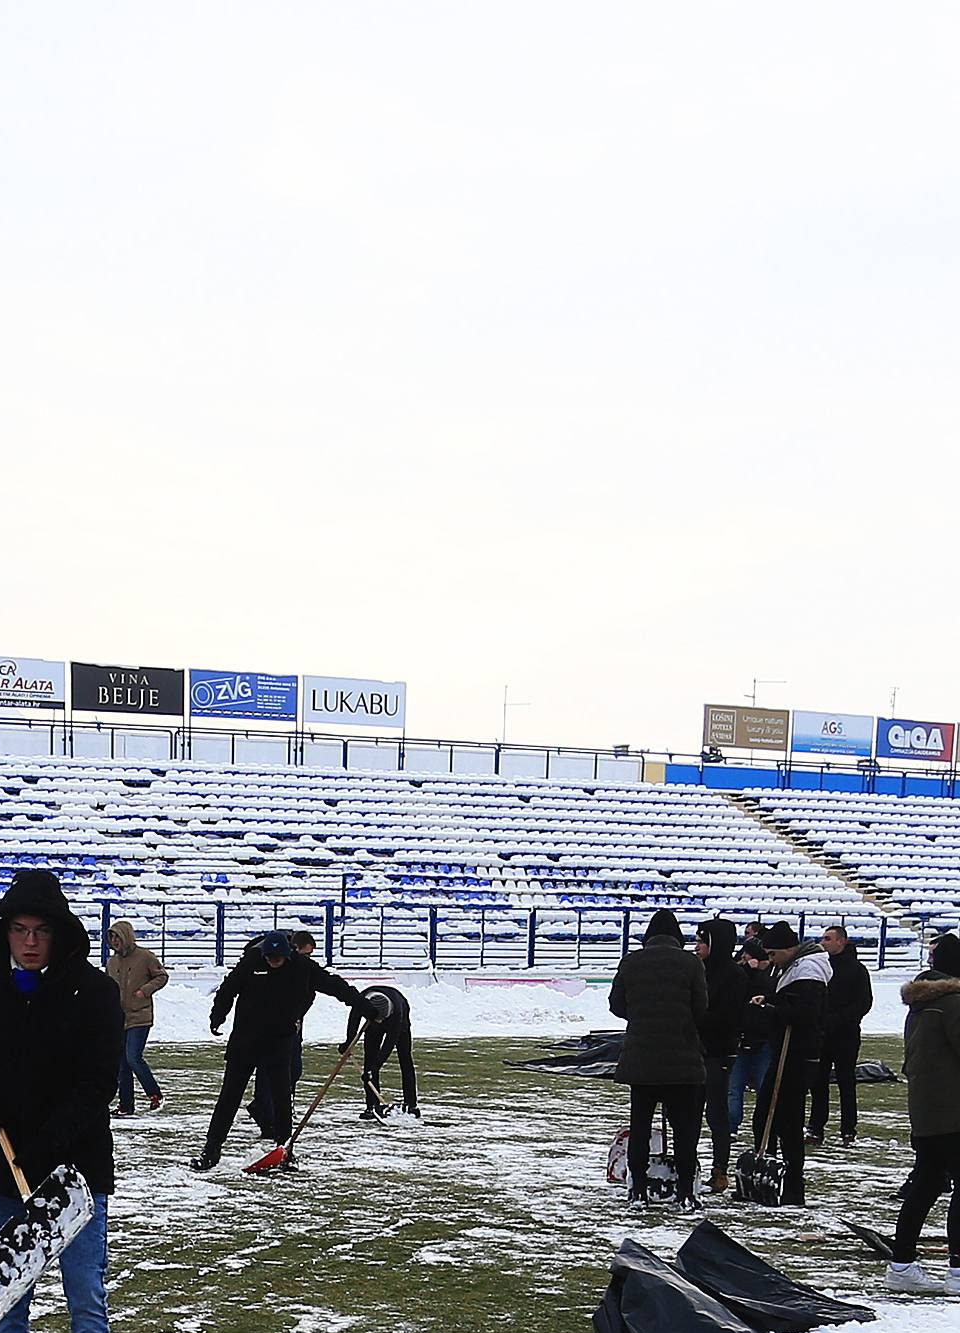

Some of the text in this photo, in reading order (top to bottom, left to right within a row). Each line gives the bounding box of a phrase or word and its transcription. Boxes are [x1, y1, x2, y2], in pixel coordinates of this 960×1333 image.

[12, 677, 53, 691] ALATA
[109, 673, 149, 685] VINA
[215, 676, 252, 700] ZVG
[98, 686, 159, 709] BELJE
[312, 689, 398, 716] LUKABU
[821, 721, 843, 734] AGS
